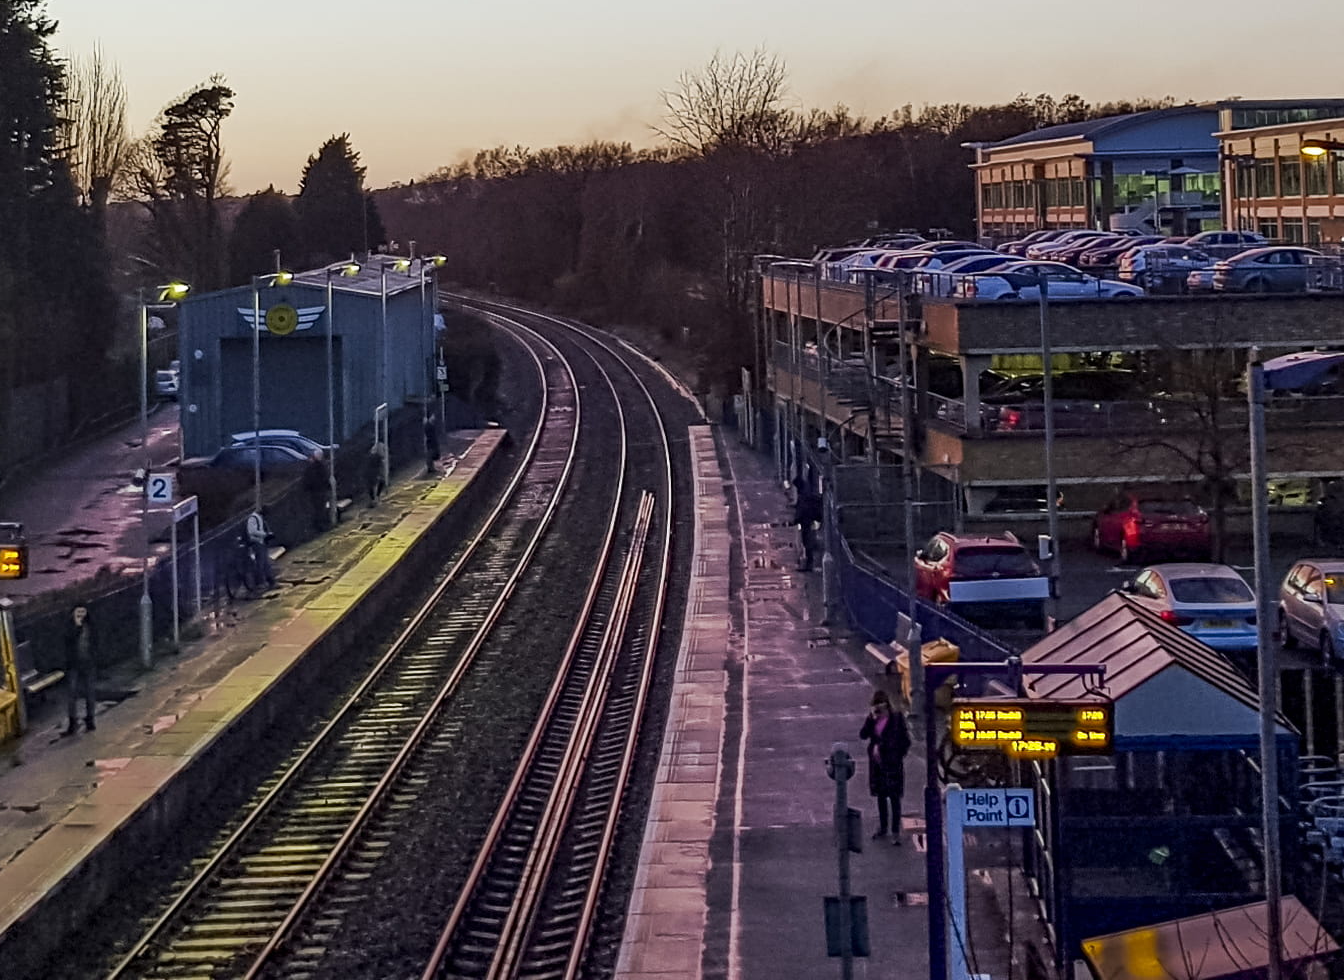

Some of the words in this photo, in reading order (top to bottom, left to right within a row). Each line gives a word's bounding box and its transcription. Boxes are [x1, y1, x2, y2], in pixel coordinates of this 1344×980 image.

[152, 478, 167, 498] 2
[965, 792, 999, 808] Help
[967, 808, 1003, 822] Point
